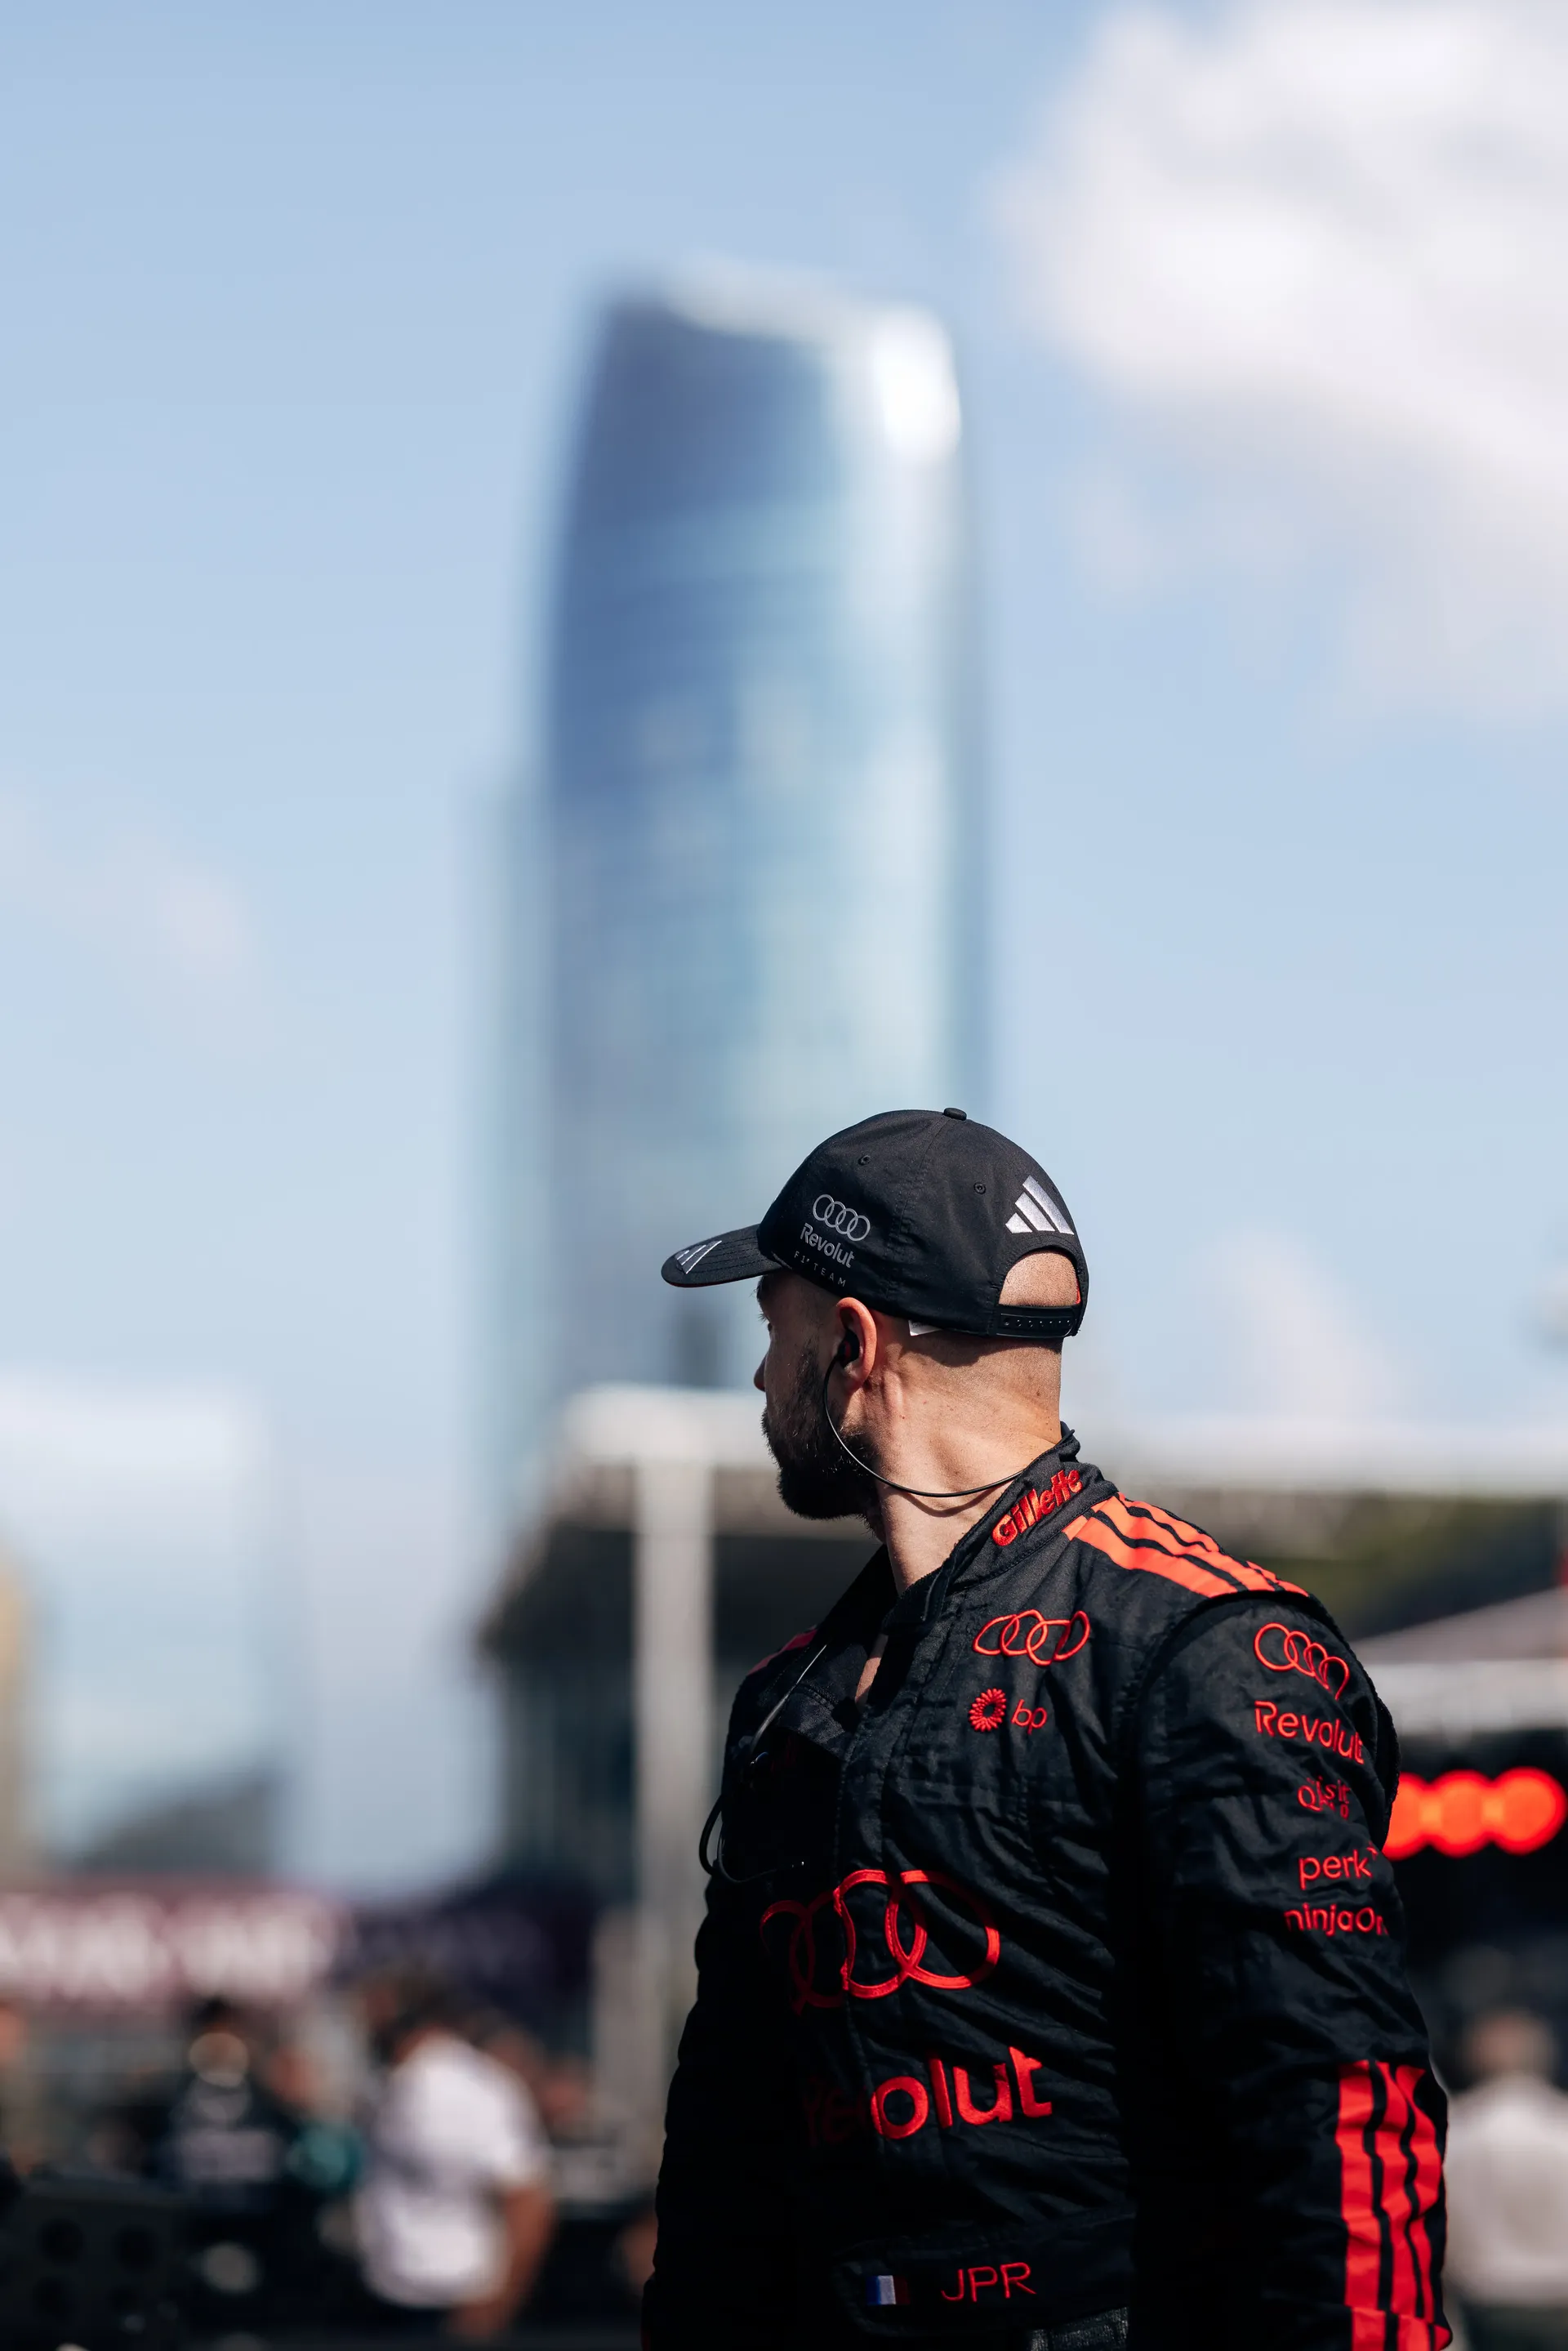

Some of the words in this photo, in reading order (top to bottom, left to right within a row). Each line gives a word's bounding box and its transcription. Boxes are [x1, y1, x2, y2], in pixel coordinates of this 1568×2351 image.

[800, 1222, 855, 1268] Revolut
[813, 1262, 846, 1287] TEAM
[991, 1469, 1084, 1546] Gillette
[1011, 1699, 1048, 1734] bp
[1254, 1699, 1365, 1764] Revolut
[1297, 1849, 1374, 1890] perk
[941, 2261, 1037, 2302] JPR
